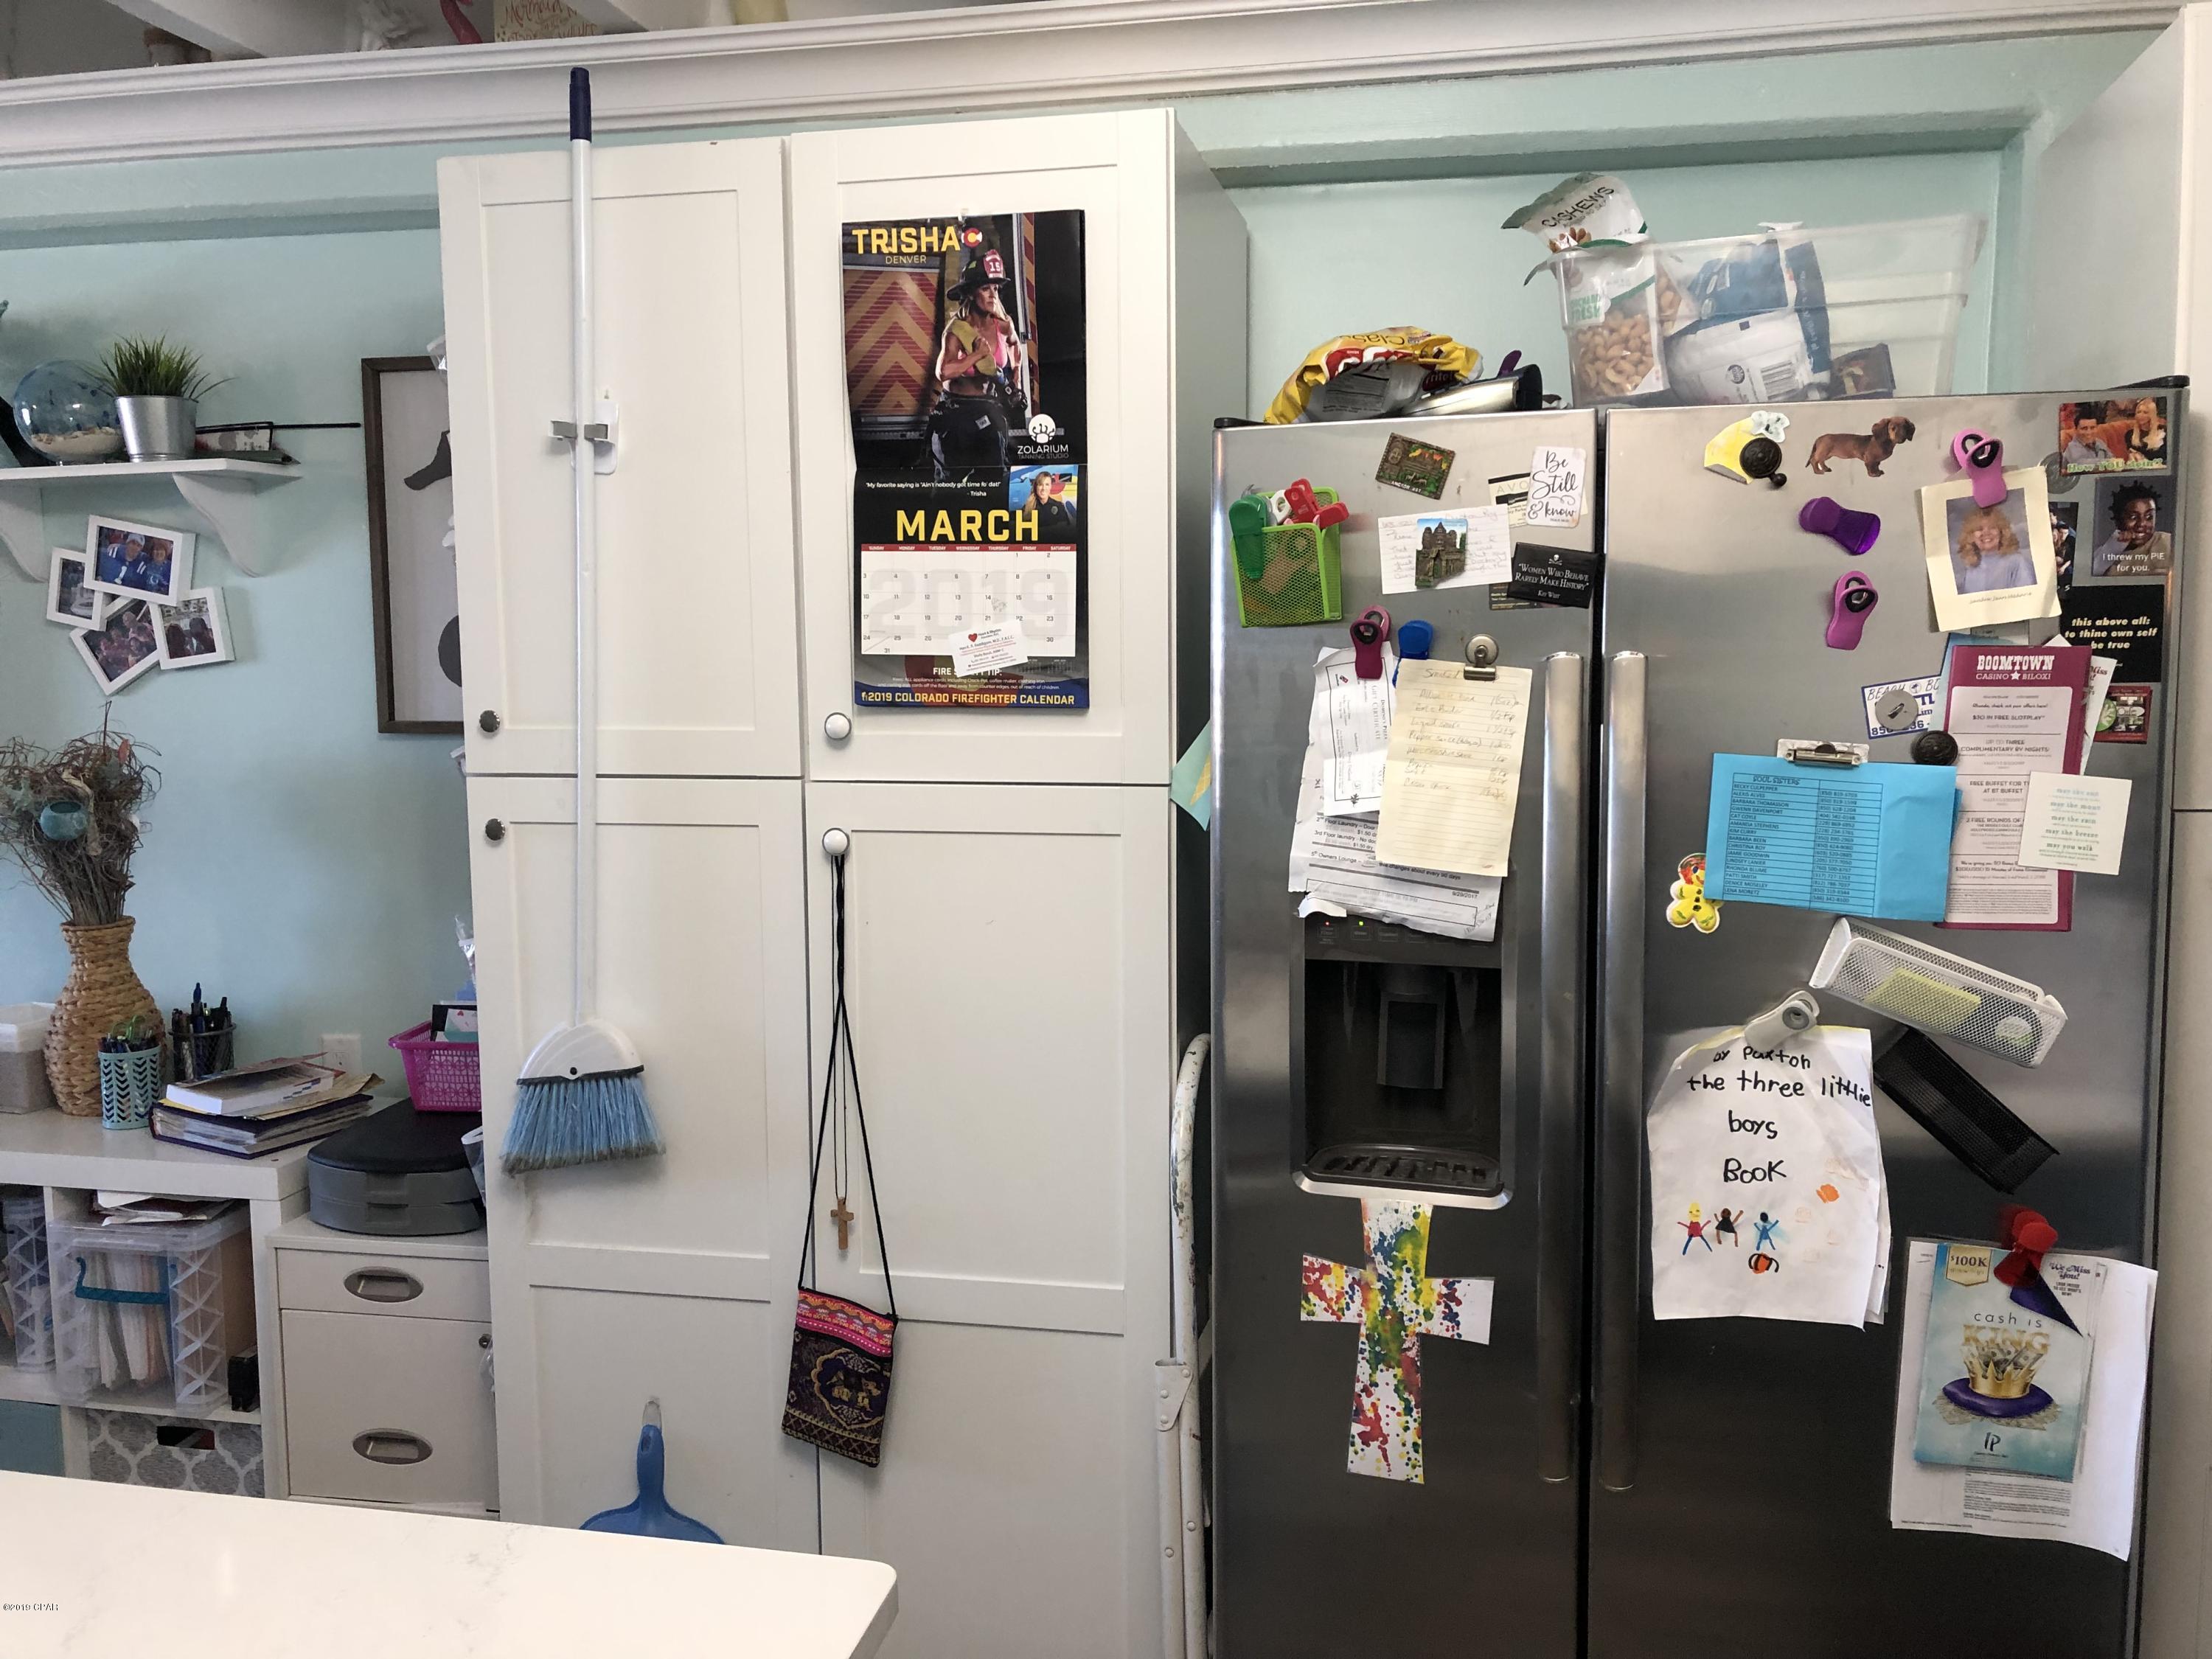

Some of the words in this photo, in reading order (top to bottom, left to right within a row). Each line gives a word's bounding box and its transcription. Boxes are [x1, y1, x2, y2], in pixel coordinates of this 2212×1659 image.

[1542, 187, 1615, 227] CASHEWS
[852, 226, 961, 254] TRISHA
[886, 255, 927, 264] DENVER
[1018, 444, 1068, 454] ZOLARIUM
[1545, 451, 1569, 473] Be
[2098, 459, 2125, 471] YOU
[1497, 480, 1528, 494] AVO
[1532, 470, 1579, 500] Still
[1545, 501, 1576, 518] know
[897, 509, 1038, 541] MARCH
[2135, 554, 2149, 563] my
[2150, 552, 2166, 560] PIE
[1514, 572, 1540, 583] RARELY
[1540, 576, 1559, 585] MAKE
[1548, 567, 1565, 577] WHO
[1564, 569, 1590, 582] BEHAVE
[2071, 617, 2093, 627] this
[2096, 617, 2128, 626] above
[2132, 616, 2151, 625] all:
[2065, 630, 2076, 639] to
[2079, 629, 2108, 638] thine
[2137, 627, 2158, 637] self
[2091, 641, 2104, 649] be
[2107, 641, 2130, 649] true
[1977, 655, 2055, 671] BOOMTOWN
[933, 667, 951, 675] FIRE
[869, 692, 892, 701] 2019
[894, 692, 949, 703] COLORADO
[952, 693, 1017, 703] FIREFIGHTER
[1020, 695, 1075, 705] CALENDAR
[1773, 777, 1801, 785] SISTERS
[1338, 820, 1358, 830] Laundry
[1337, 833, 1355, 842] laundry
[1318, 852, 1338, 860] Owners
[1338, 855, 1357, 864] Lounge
[1388, 863, 1410, 873] changes
[1411, 866, 1425, 874] about
[1426, 869, 1440, 878] every
[1743, 1046, 1811, 1069] Paxton
[1687, 1074, 1725, 1091] the
[1736, 1070, 1805, 1097] three
[1728, 1110, 1778, 1139] boys
[1950, 1255, 1988, 1267] $100K
[1974, 1312, 2017, 1325] cash
[2028, 1319, 2042, 1328] is
